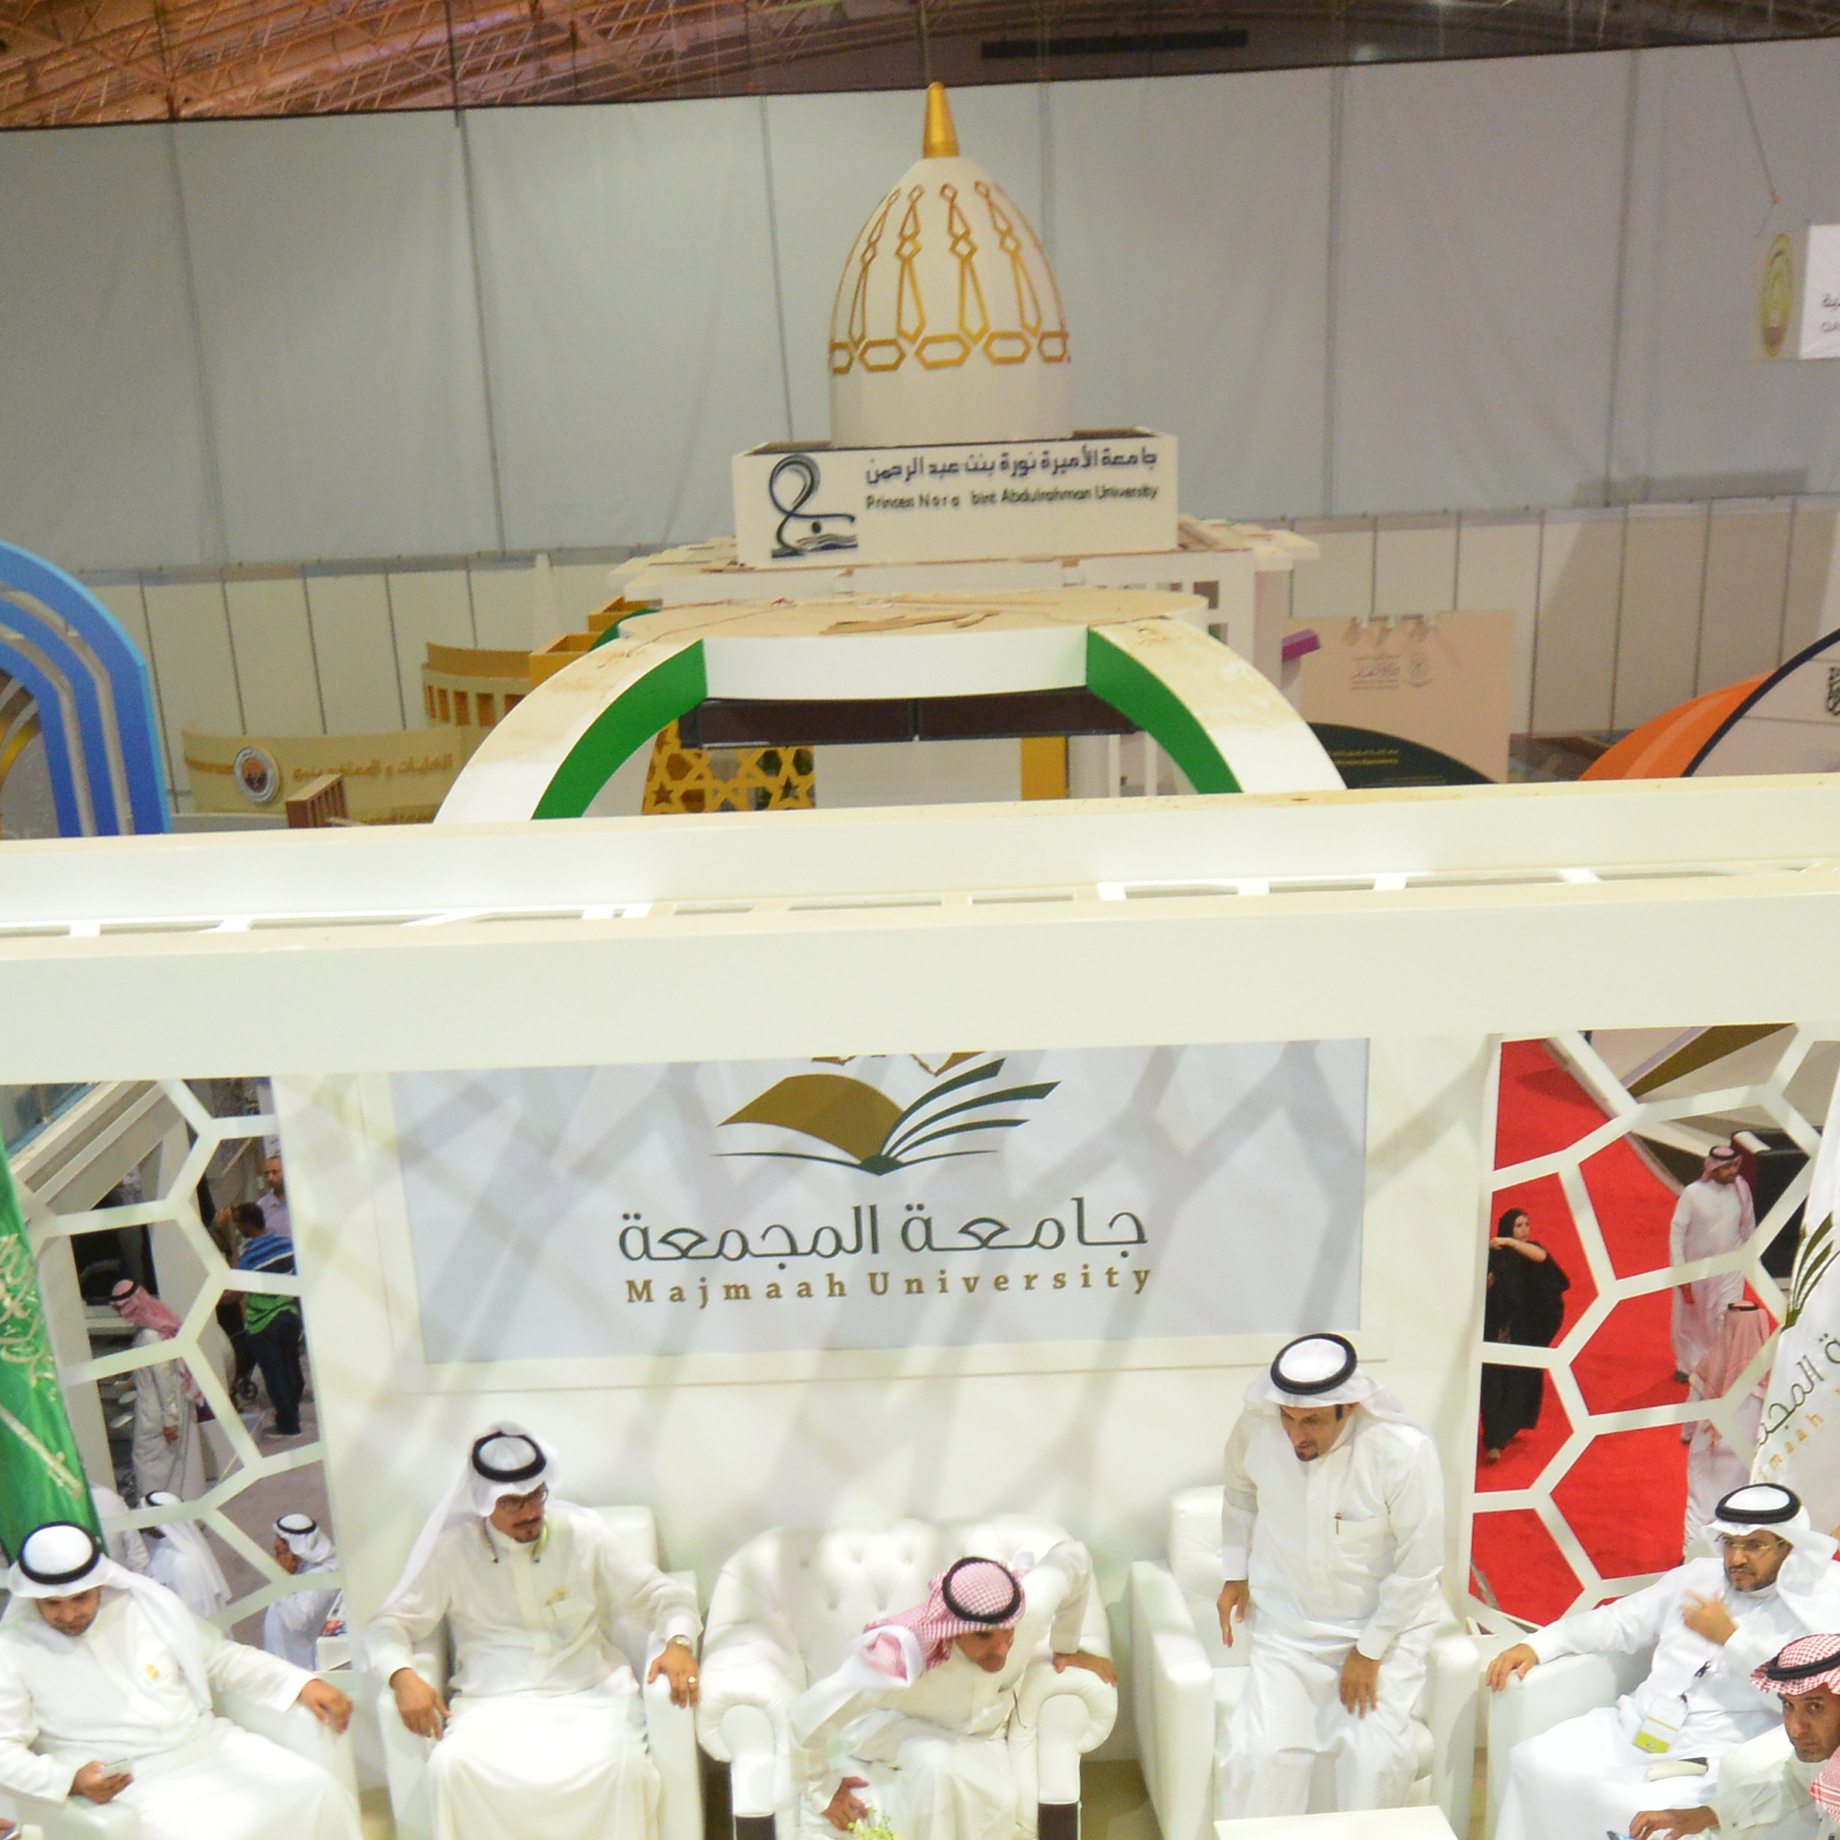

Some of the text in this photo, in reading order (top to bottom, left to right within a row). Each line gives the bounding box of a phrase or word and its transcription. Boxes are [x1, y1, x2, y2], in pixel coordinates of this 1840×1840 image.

[865, 443, 1158, 485] جامعة الأميرة نورة بنت عبد الرحمن
[1095, 484, 1158, 501] University
[618, 1196, 1148, 1271] جامعة المجمعة
[625, 1263, 1151, 1309] Majmaah University
